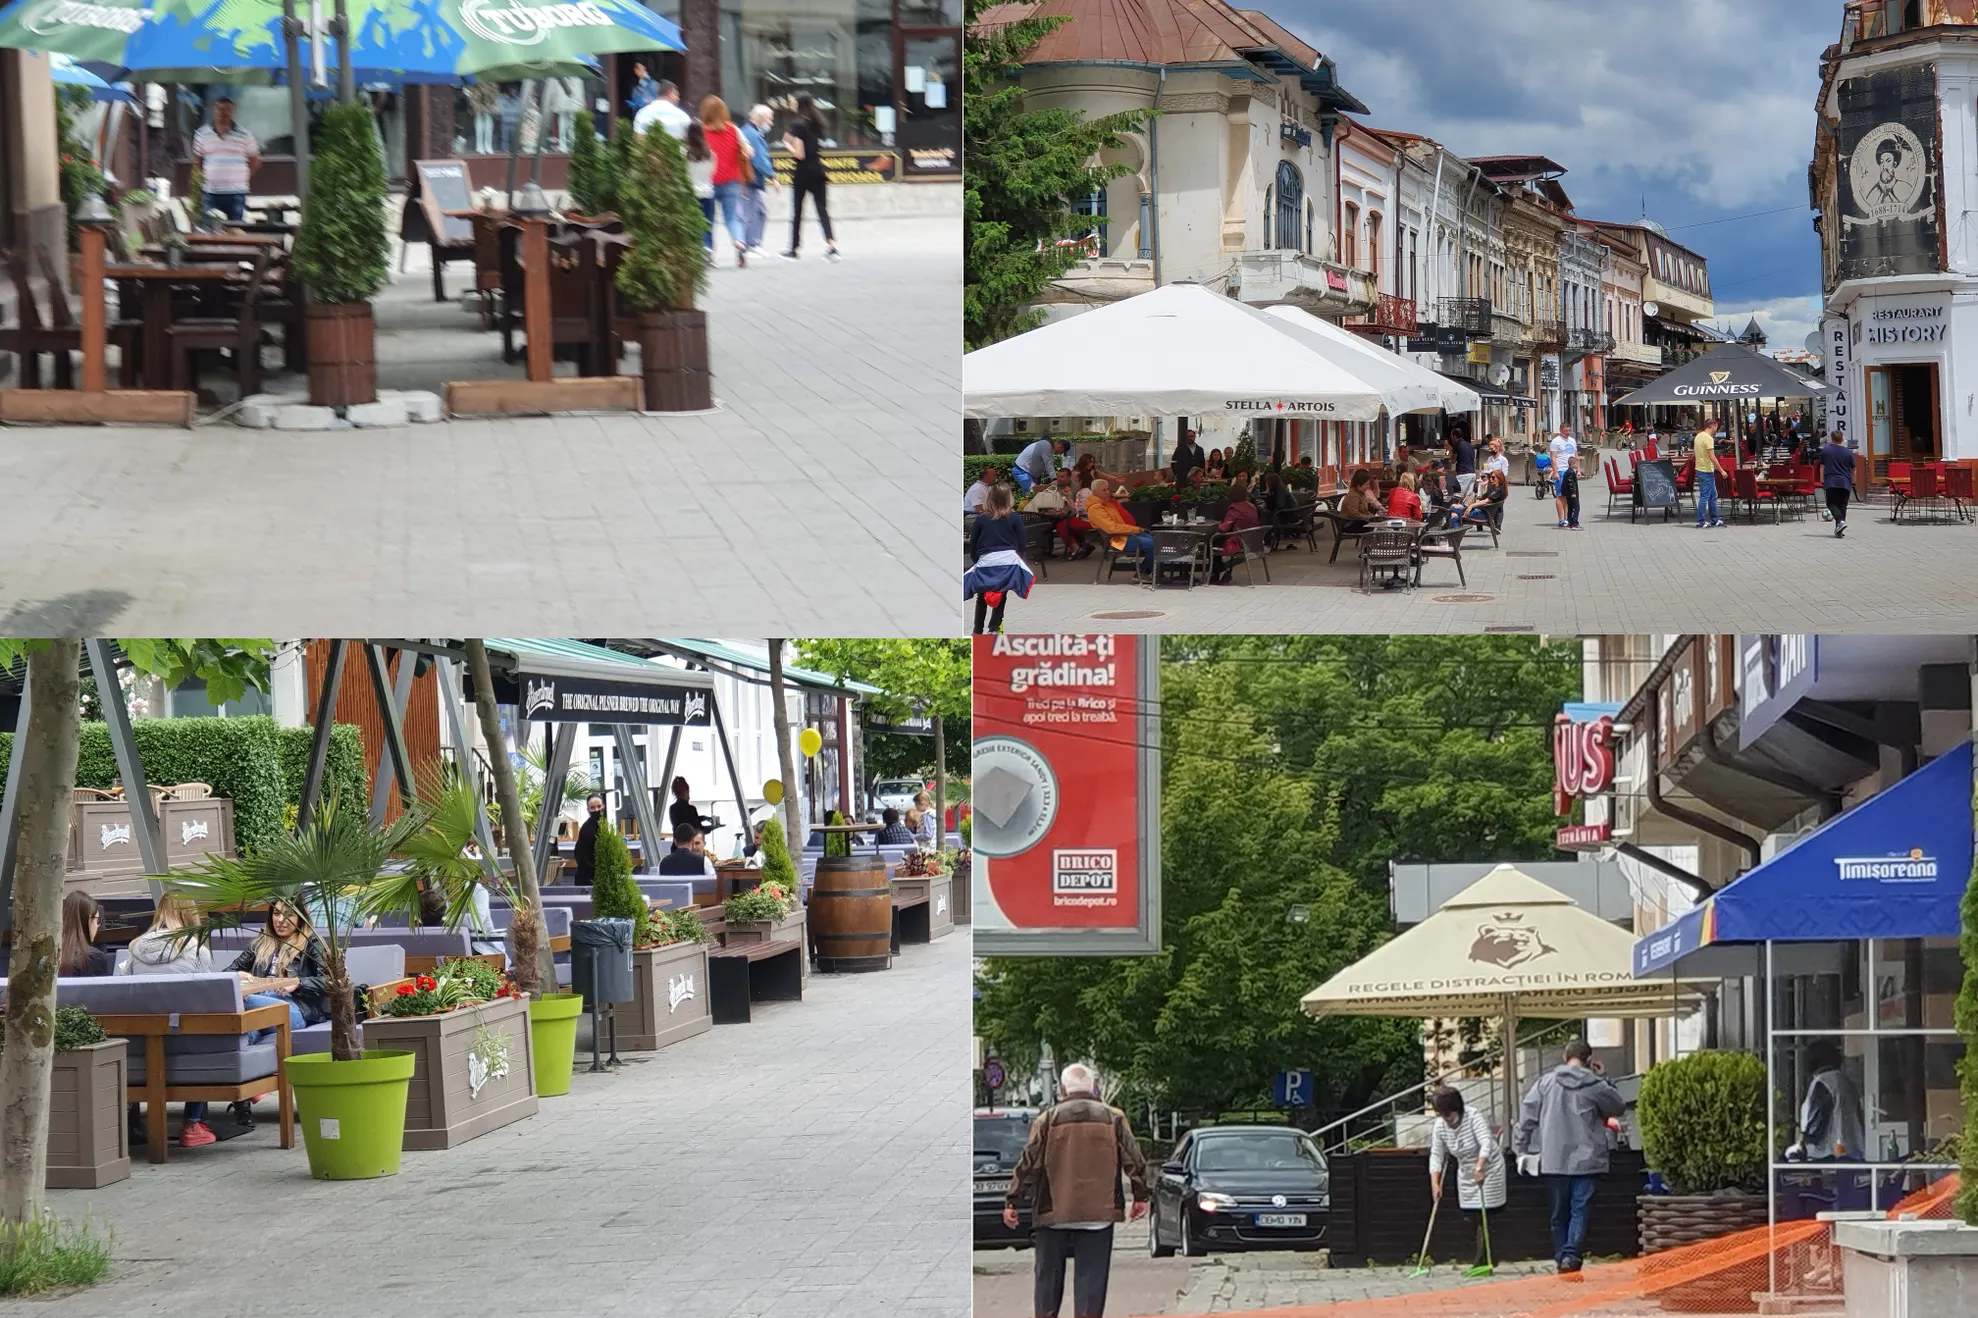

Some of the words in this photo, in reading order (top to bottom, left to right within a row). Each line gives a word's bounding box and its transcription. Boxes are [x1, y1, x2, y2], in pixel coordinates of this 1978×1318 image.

[476, 1, 616, 35] TUBORG
[1872, 307, 1943, 320] RESTAURANT
[1833, 330, 1847, 431] RESTAUR
[1673, 384, 1760, 396] GUINNESS
[1225, 400, 1272, 411] STELLA
[1287, 402, 1335, 412] ARTOIS
[1011, 661, 1116, 693] grădina!
[562, 693, 573, 710] THE
[573, 693, 599, 711] ORIGINAL
[1077, 698, 1106, 709] Brico
[1060, 856, 1112, 869] BRICO
[1348, 981, 1424, 993] REGELE
[1286, 1071, 1302, 1101] P
